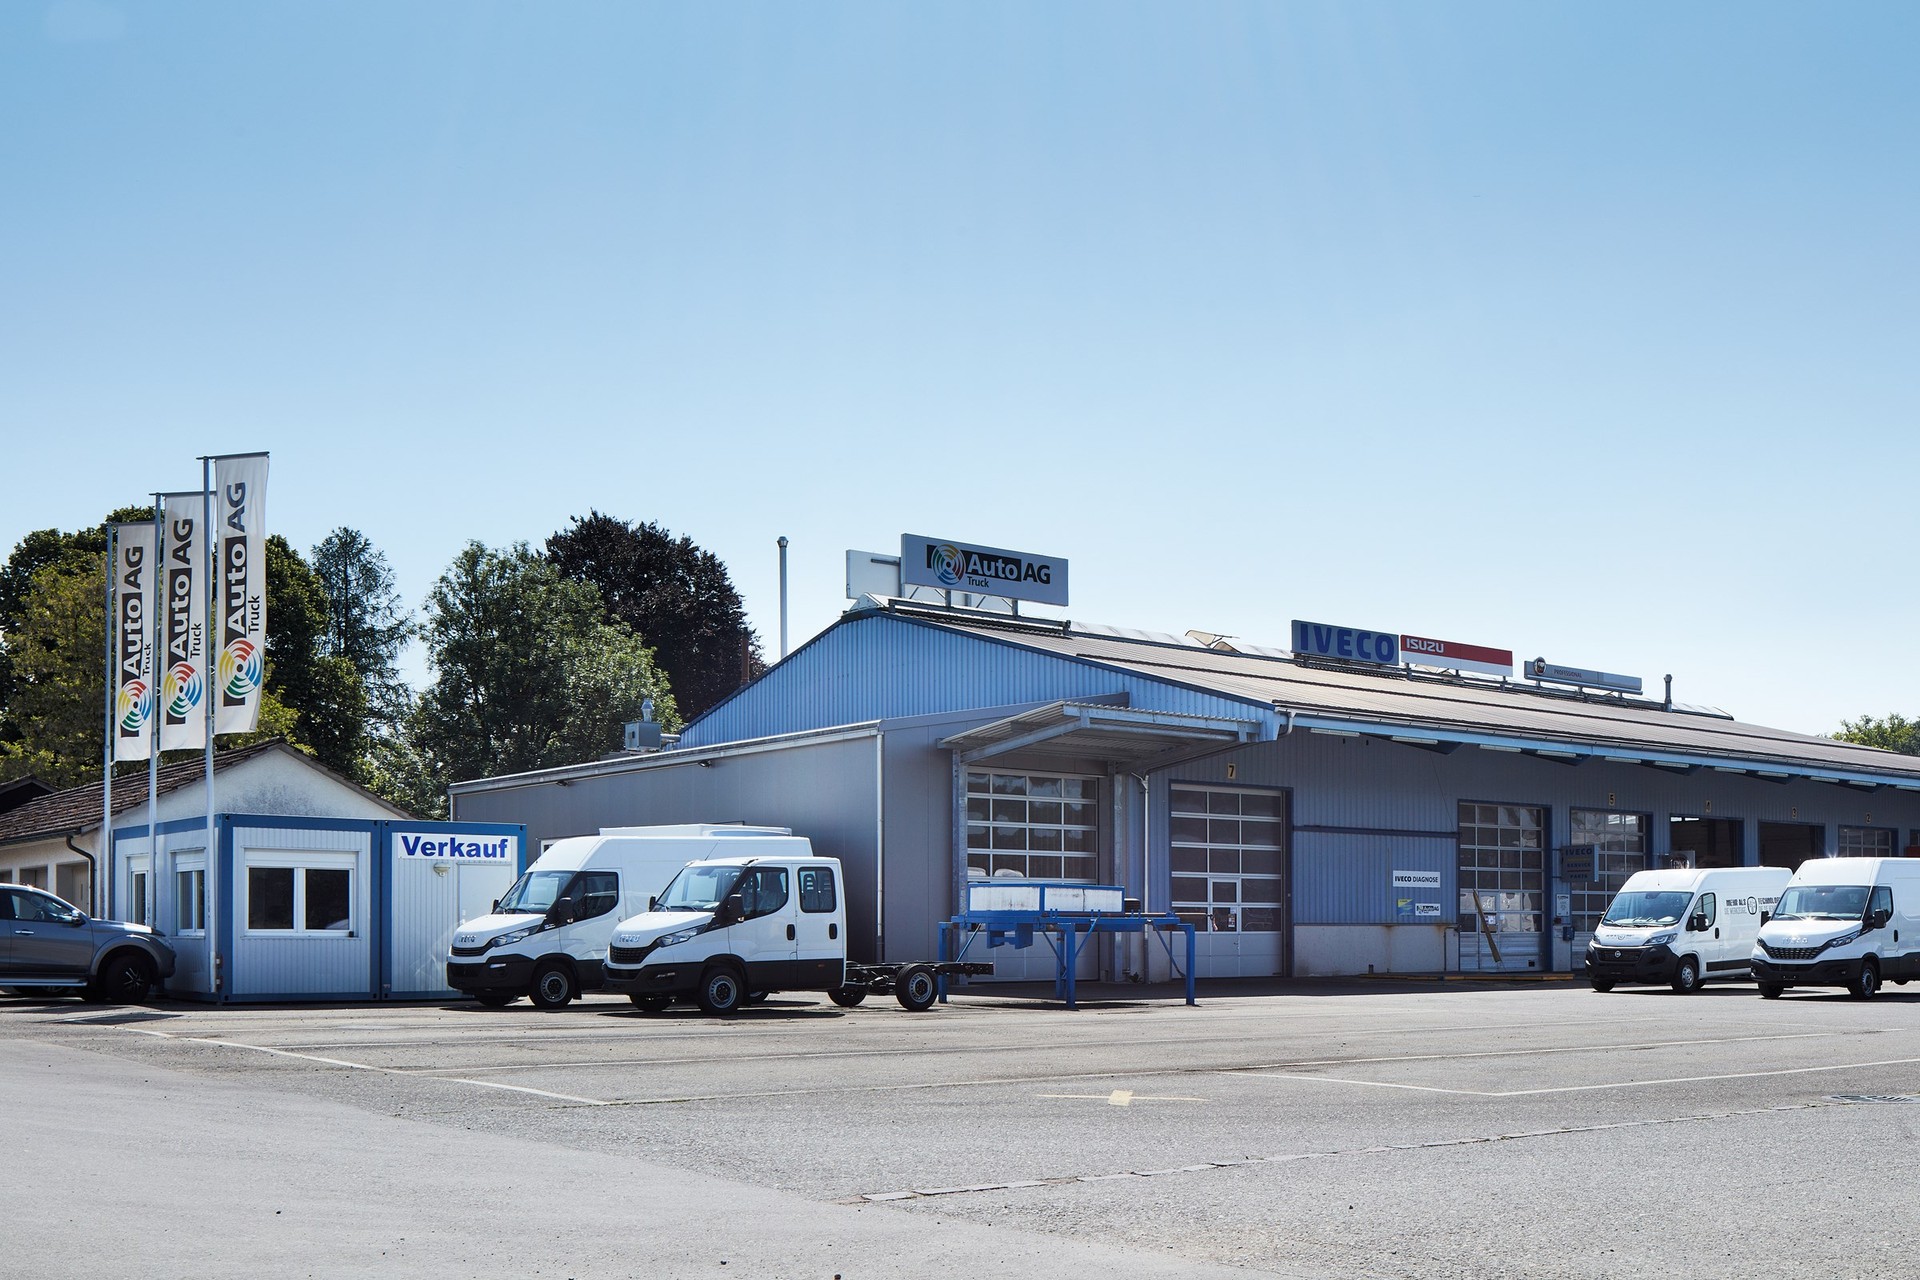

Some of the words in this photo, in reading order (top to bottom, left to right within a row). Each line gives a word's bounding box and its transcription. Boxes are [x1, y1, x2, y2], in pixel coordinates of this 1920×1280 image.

[226, 482, 246, 534] AG
[172, 518, 194, 566] AG
[124, 546, 144, 590] AG
[966, 553, 1020, 581] Auto
[1022, 562, 1051, 585] AG
[967, 575, 990, 589] Truck
[227, 543, 247, 635] Auto
[170, 573, 191, 659] Auto
[248, 594, 261, 635] Truck
[123, 597, 143, 677] Auto
[190, 622, 202, 659] Truck
[1300, 623, 1395, 662] IVECO
[1405, 637, 1445, 654] ISUZU
[142, 642, 152, 677] Truck
[1228, 764, 1235, 778] 7
[400, 835, 509, 859] Verkauf
[1565, 848, 1593, 856] IVECO
[1394, 875, 1412, 883] IVECO
